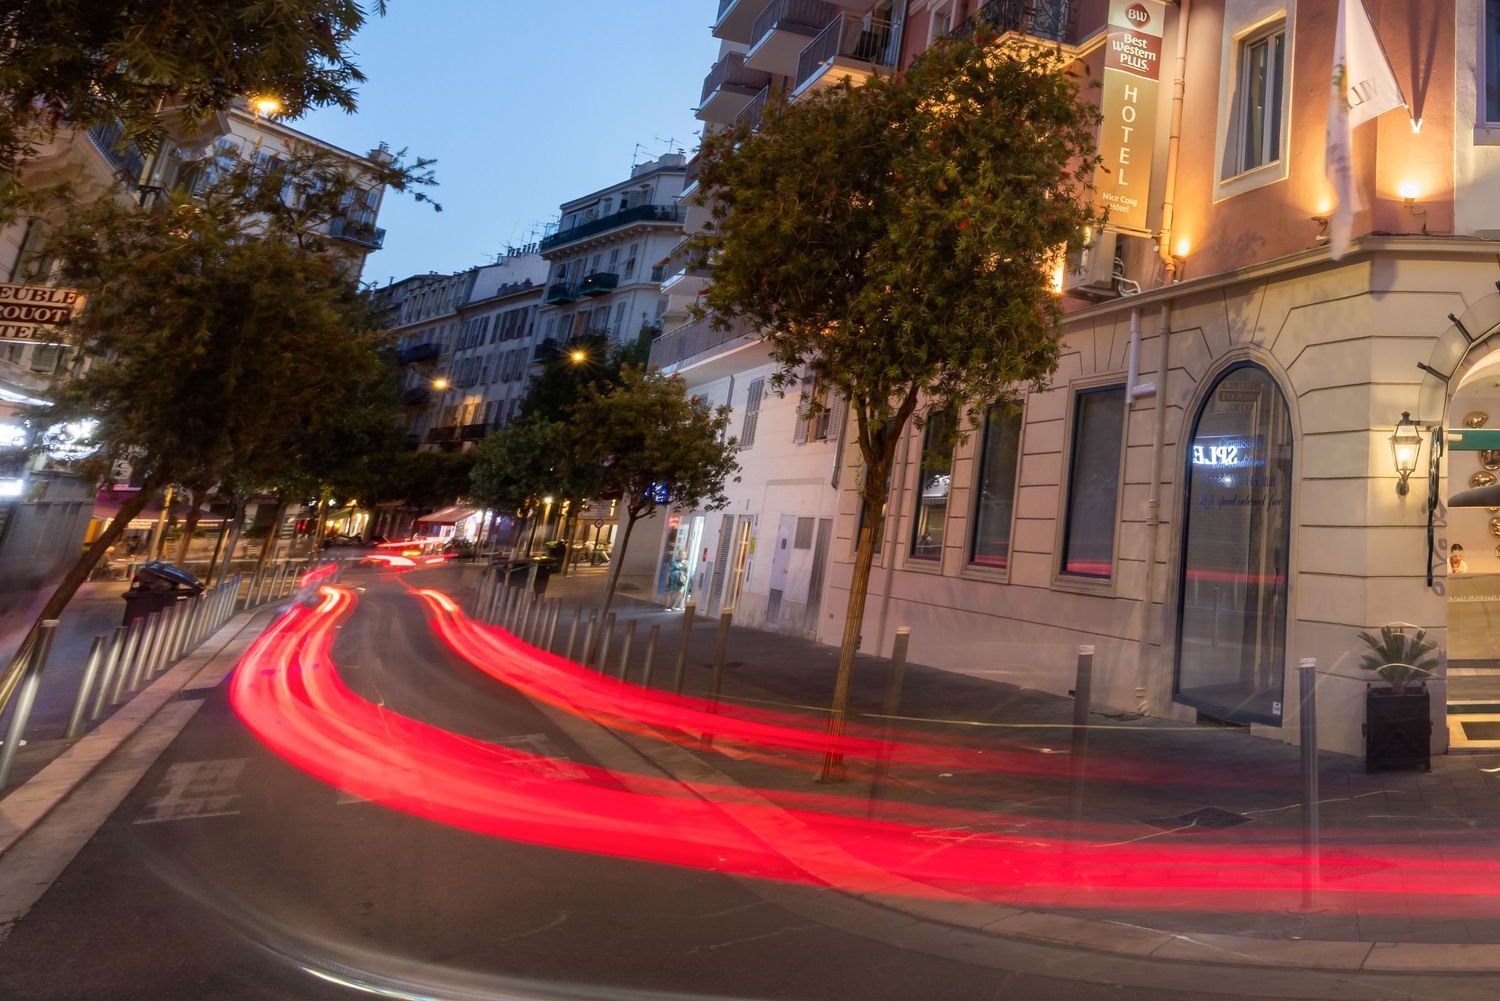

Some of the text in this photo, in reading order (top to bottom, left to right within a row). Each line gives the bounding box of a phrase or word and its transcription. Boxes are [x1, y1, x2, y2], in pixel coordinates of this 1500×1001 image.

[1128, 8, 1148, 22] BW
[1124, 33, 1148, 49] Best
[1112, 40, 1157, 61] Western
[1118, 84, 1138, 186] HOTEL
[1102, 192, 1138, 207] Nice Cosy
